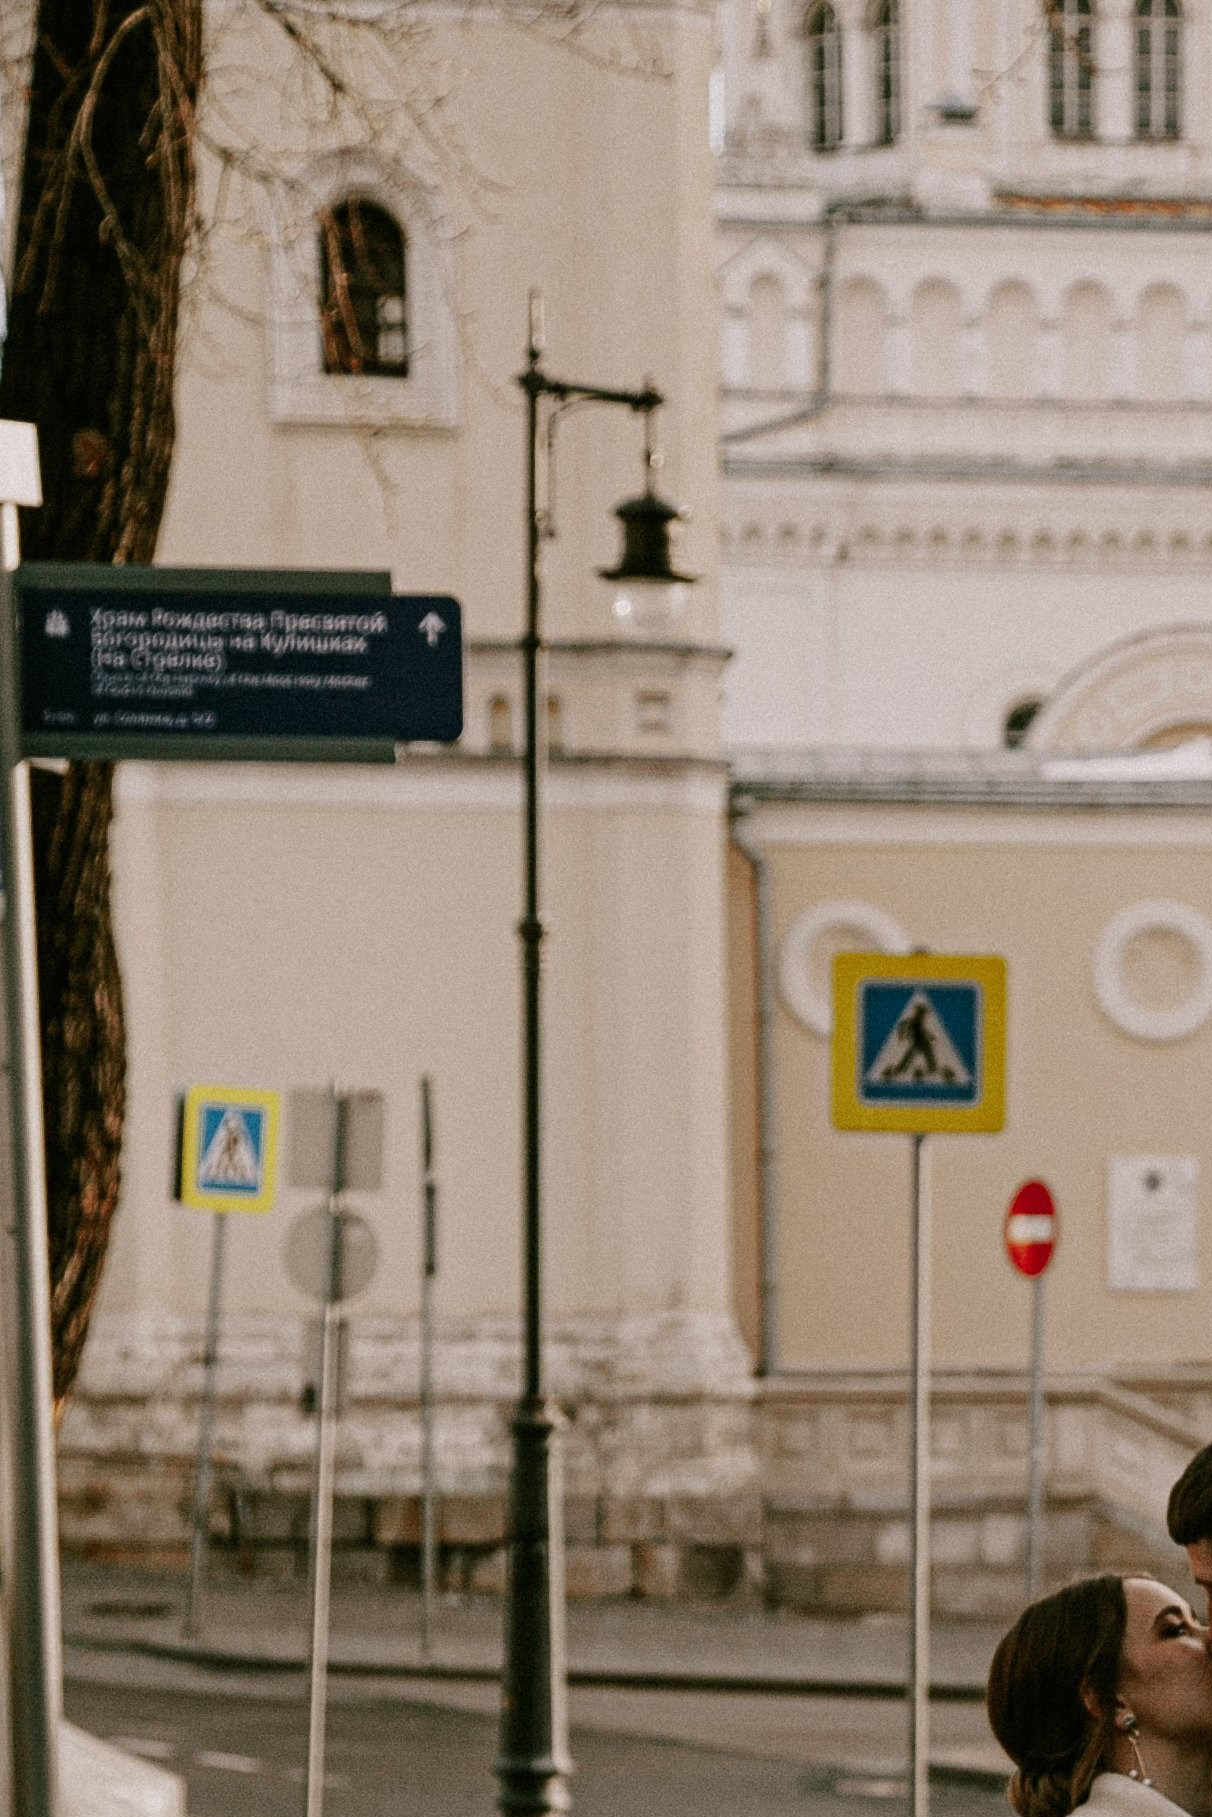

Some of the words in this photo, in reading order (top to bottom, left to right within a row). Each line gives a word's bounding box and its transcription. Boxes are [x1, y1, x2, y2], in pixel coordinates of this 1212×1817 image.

[91, 607, 148, 631] Храм
[152, 608, 267, 632] Рождества
[270, 609, 387, 634] Пресвятой
[91, 629, 225, 651] Богородицы
[230, 634, 256, 650] на
[261, 632, 368, 656] Кулишках
